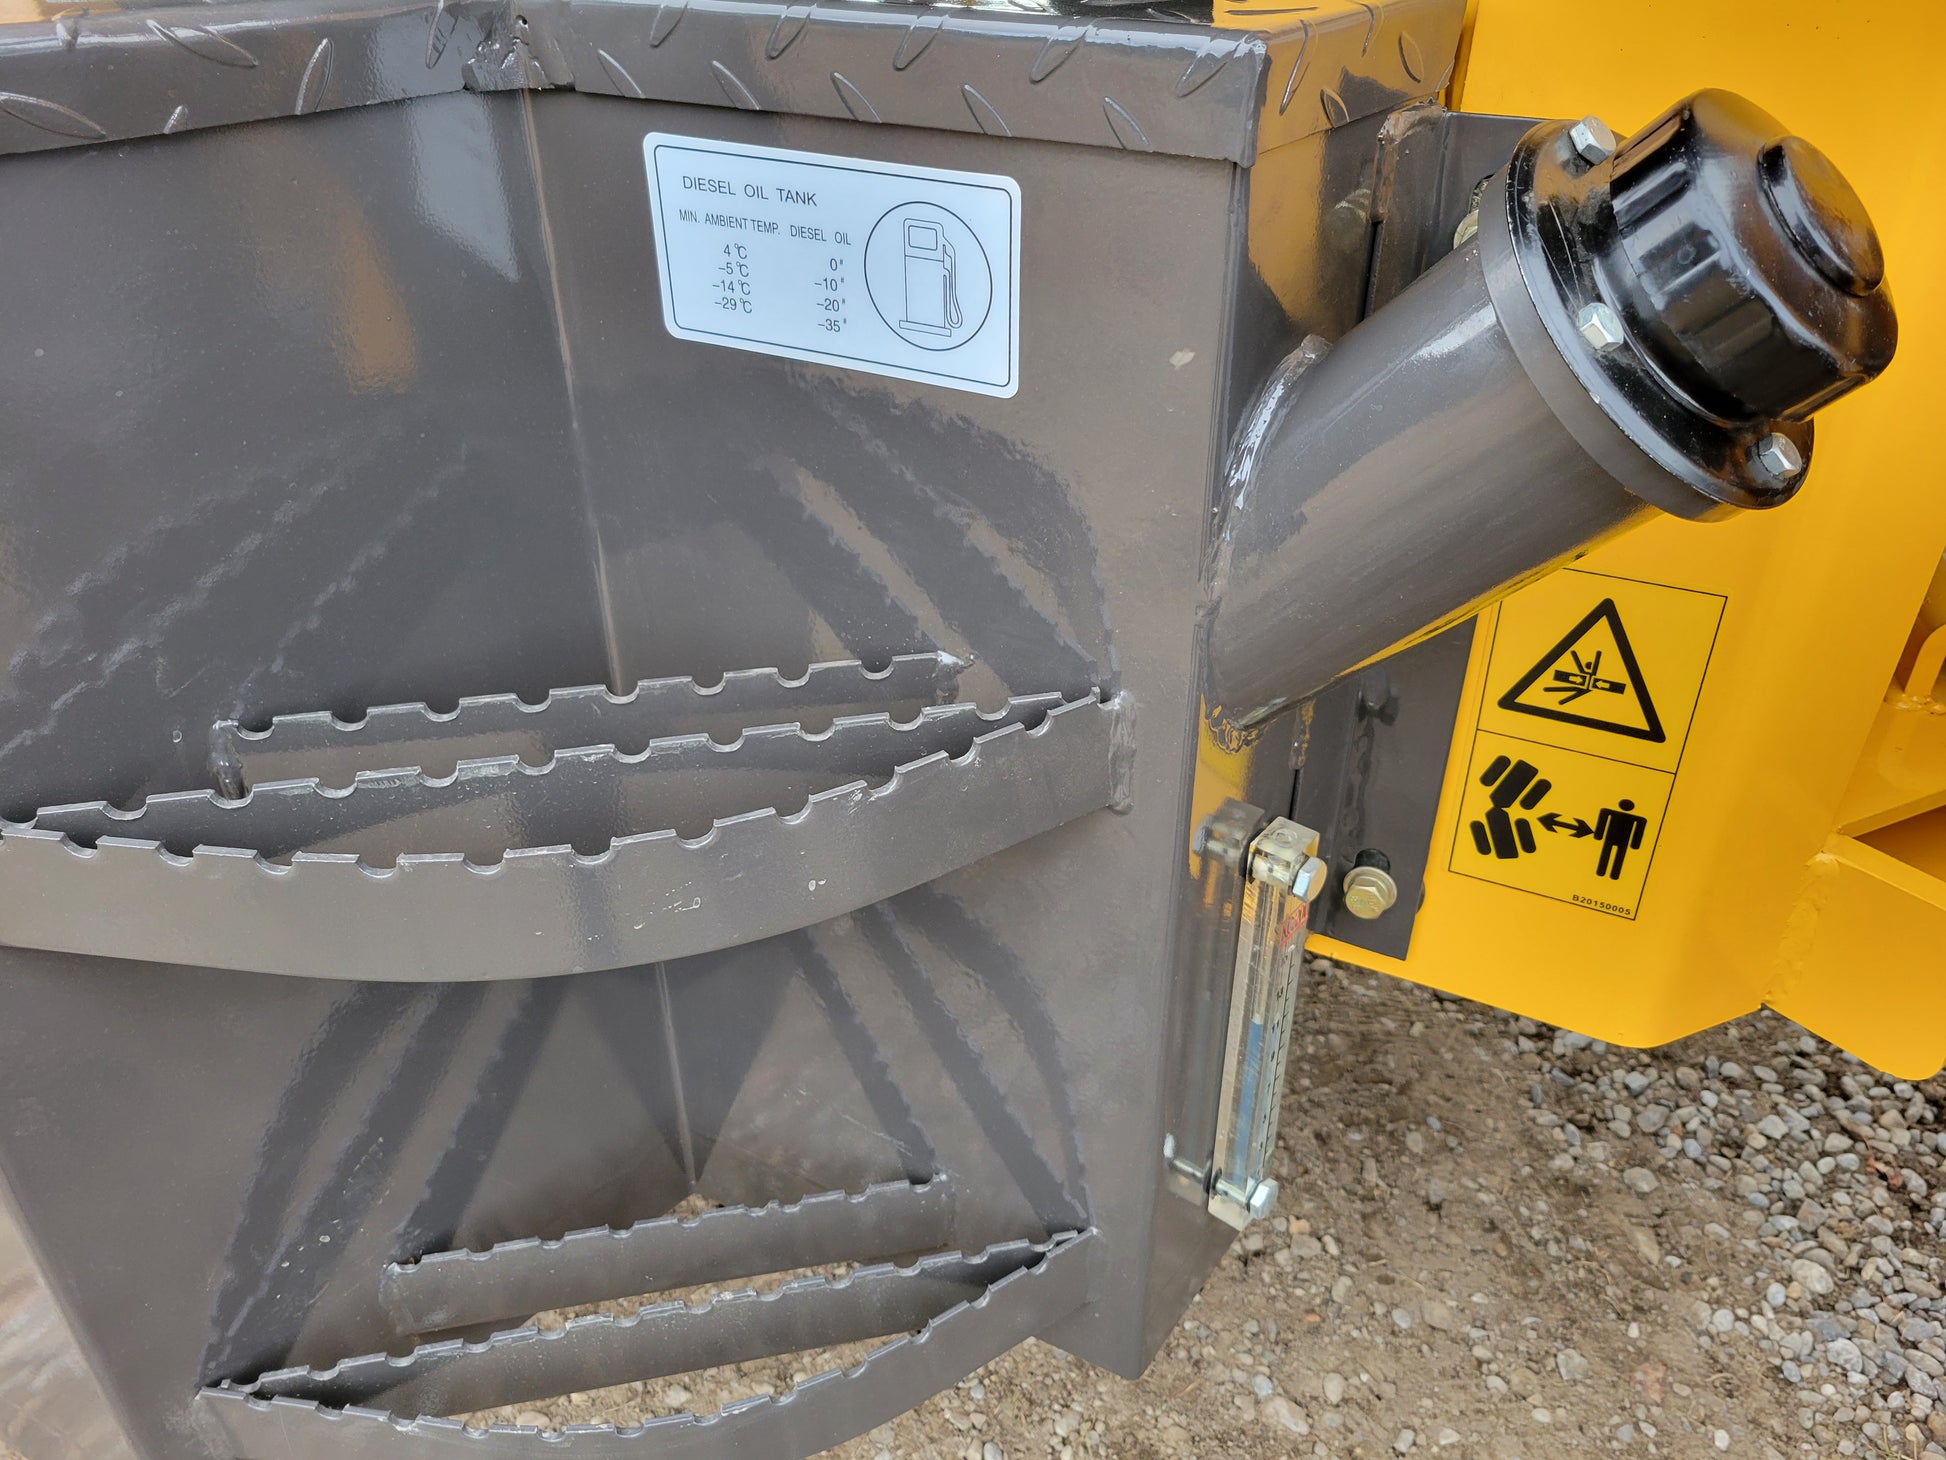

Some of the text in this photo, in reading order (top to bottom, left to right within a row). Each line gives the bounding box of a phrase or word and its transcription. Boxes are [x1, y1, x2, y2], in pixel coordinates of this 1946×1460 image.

[682, 175, 818, 207] DIESEL OIL TANK
[679, 208, 781, 235] MIN. AMBIENT TEMP.
[790, 224, 852, 246] DIESEL OIL
[1572, 894, 1631, 915] B20150005
